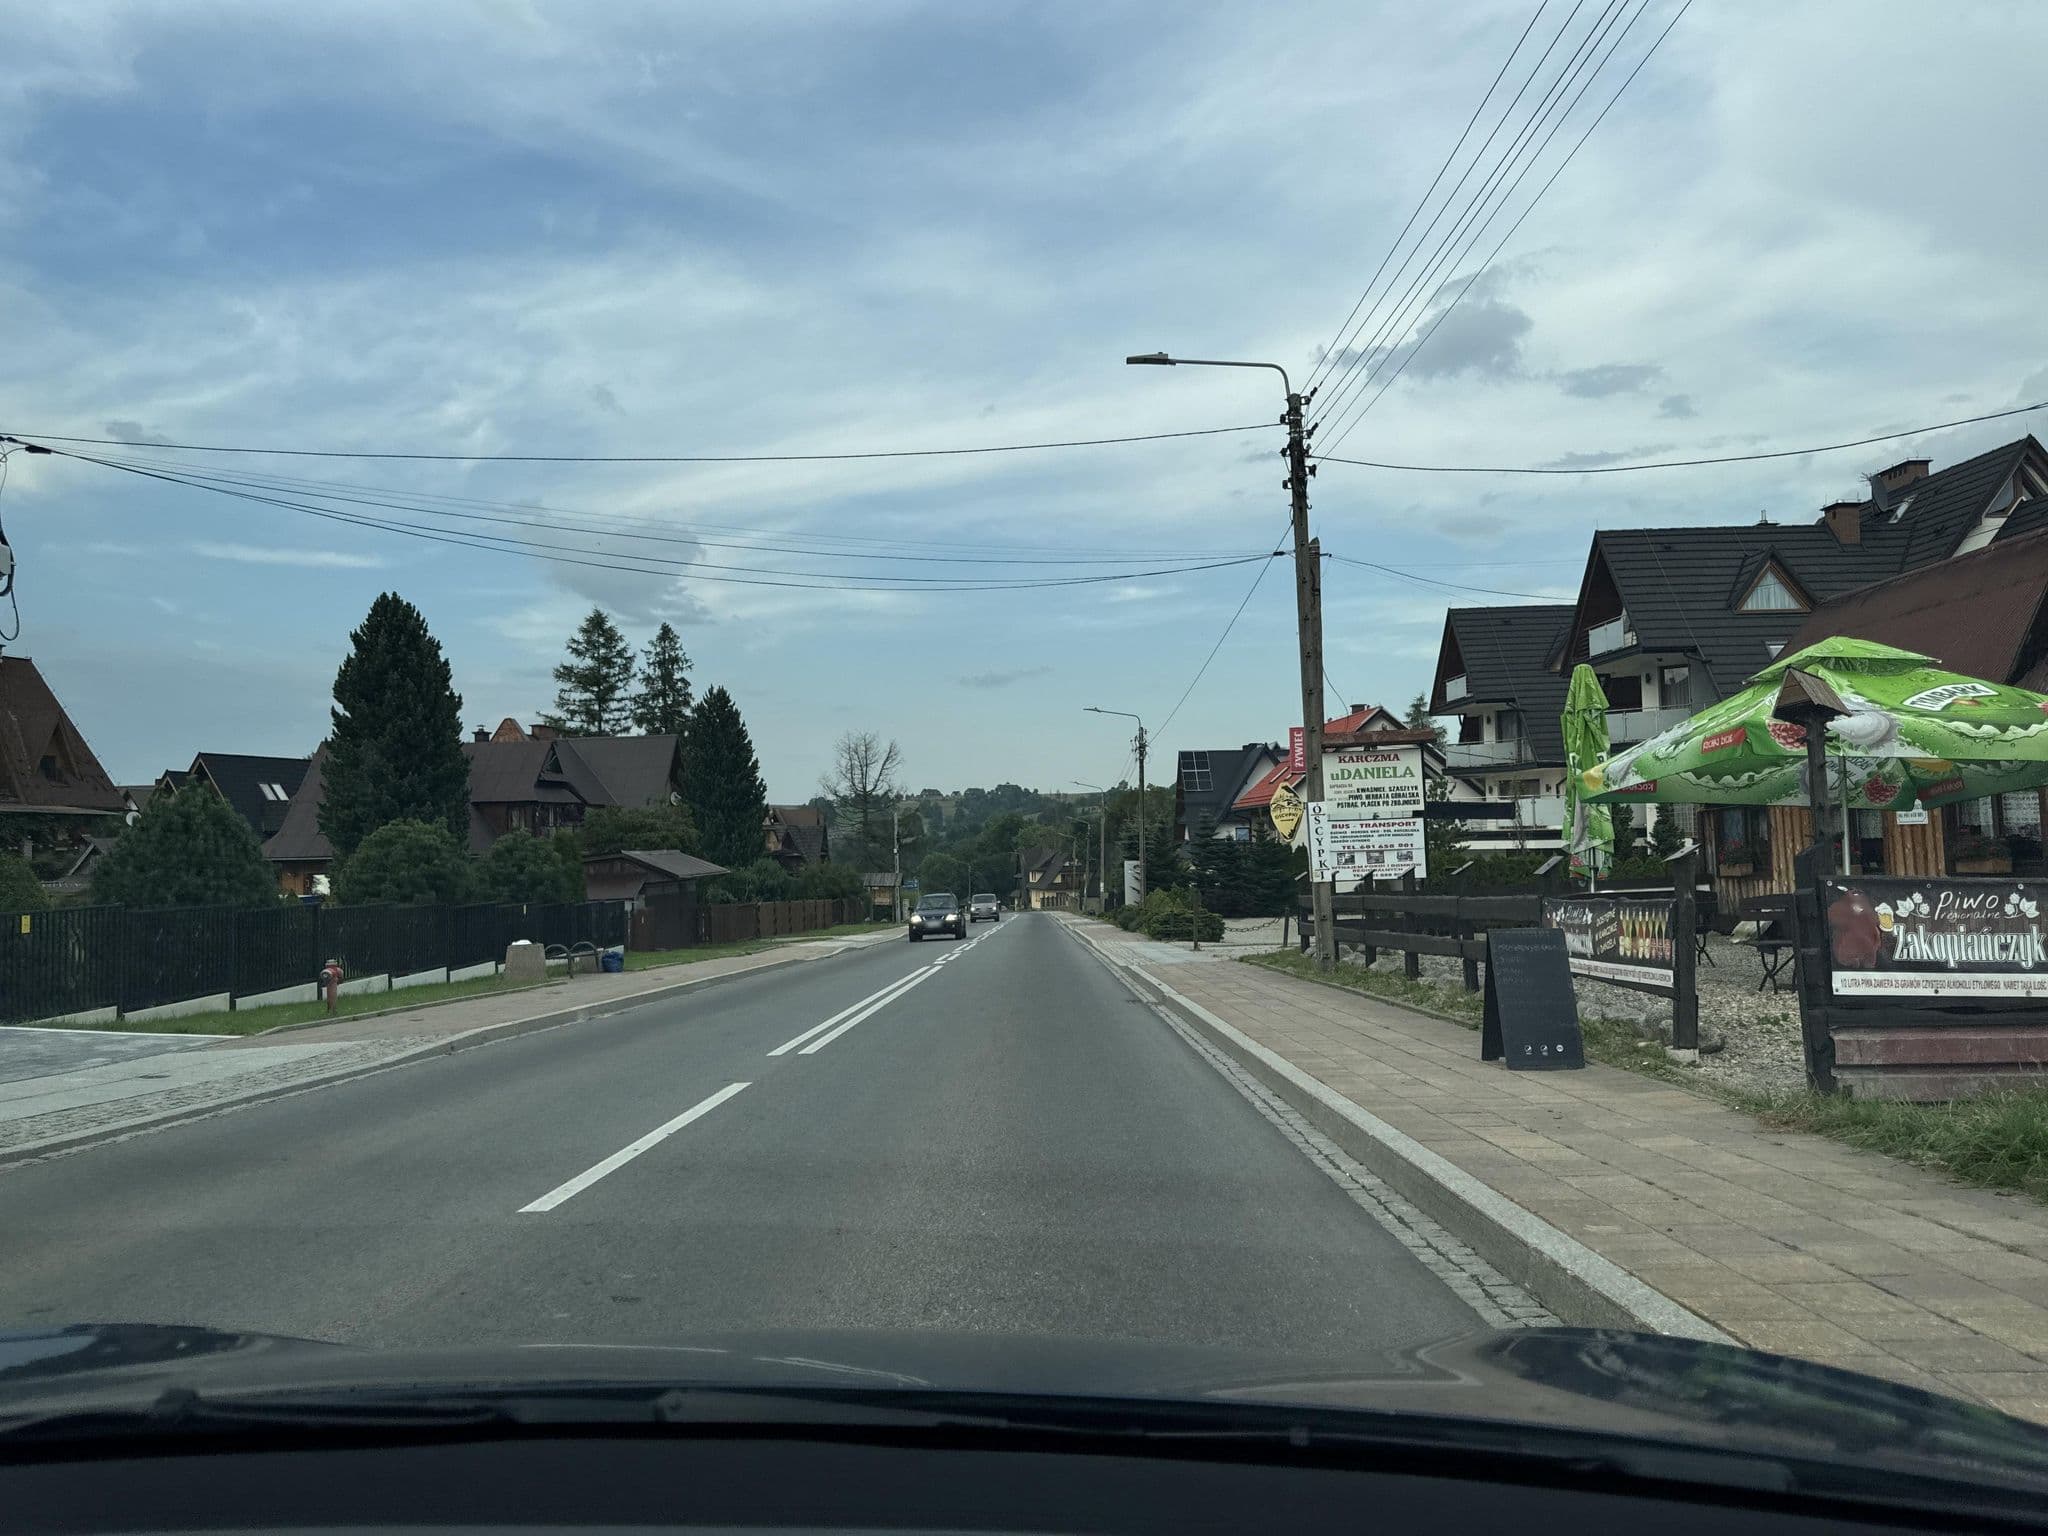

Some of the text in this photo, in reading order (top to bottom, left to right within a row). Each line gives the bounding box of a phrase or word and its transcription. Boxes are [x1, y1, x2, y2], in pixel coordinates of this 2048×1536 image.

[1909, 684, 1984, 709] TYMBARK
[1293, 730, 1304, 768] ŻYWIEC
[1337, 753, 1401, 764] KARCZMA
[1359, 821, 1417, 829] TRANSPORT
[1934, 891, 2000, 921] Piwo
[1940, 911, 2000, 923] regionalne
